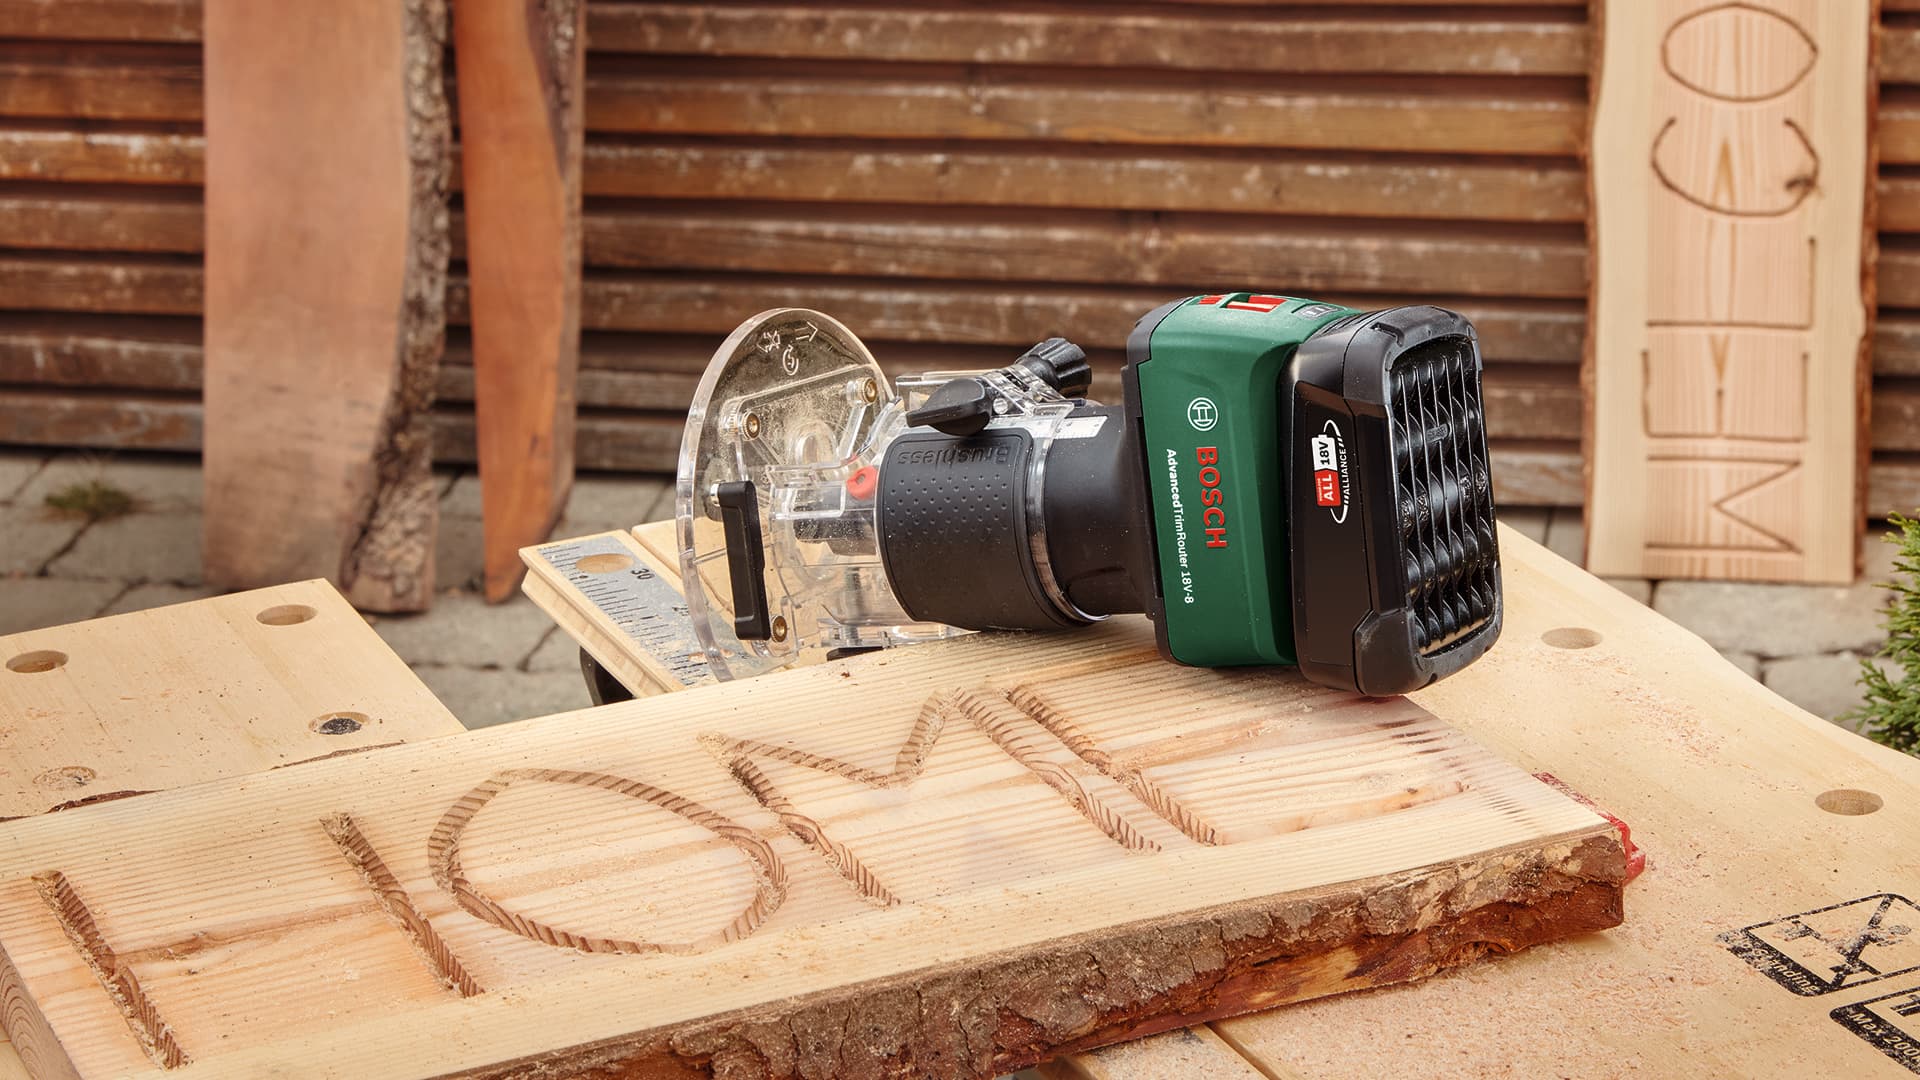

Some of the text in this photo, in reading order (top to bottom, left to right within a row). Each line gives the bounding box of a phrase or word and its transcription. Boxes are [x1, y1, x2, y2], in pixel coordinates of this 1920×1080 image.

[896, 446, 1009, 469] Brushless
[1318, 441, 1330, 465] 18V
[1339, 448, 1350, 496] ALLIANCE
[1196, 446, 1228, 548] BOSCH
[1321, 473, 1334, 502] ALL
[1166, 448, 1194, 604] AdvancedTrimRouter 18V-8
[631, 568, 656, 581] 30
[1850, 1011, 1885, 1036] Max
